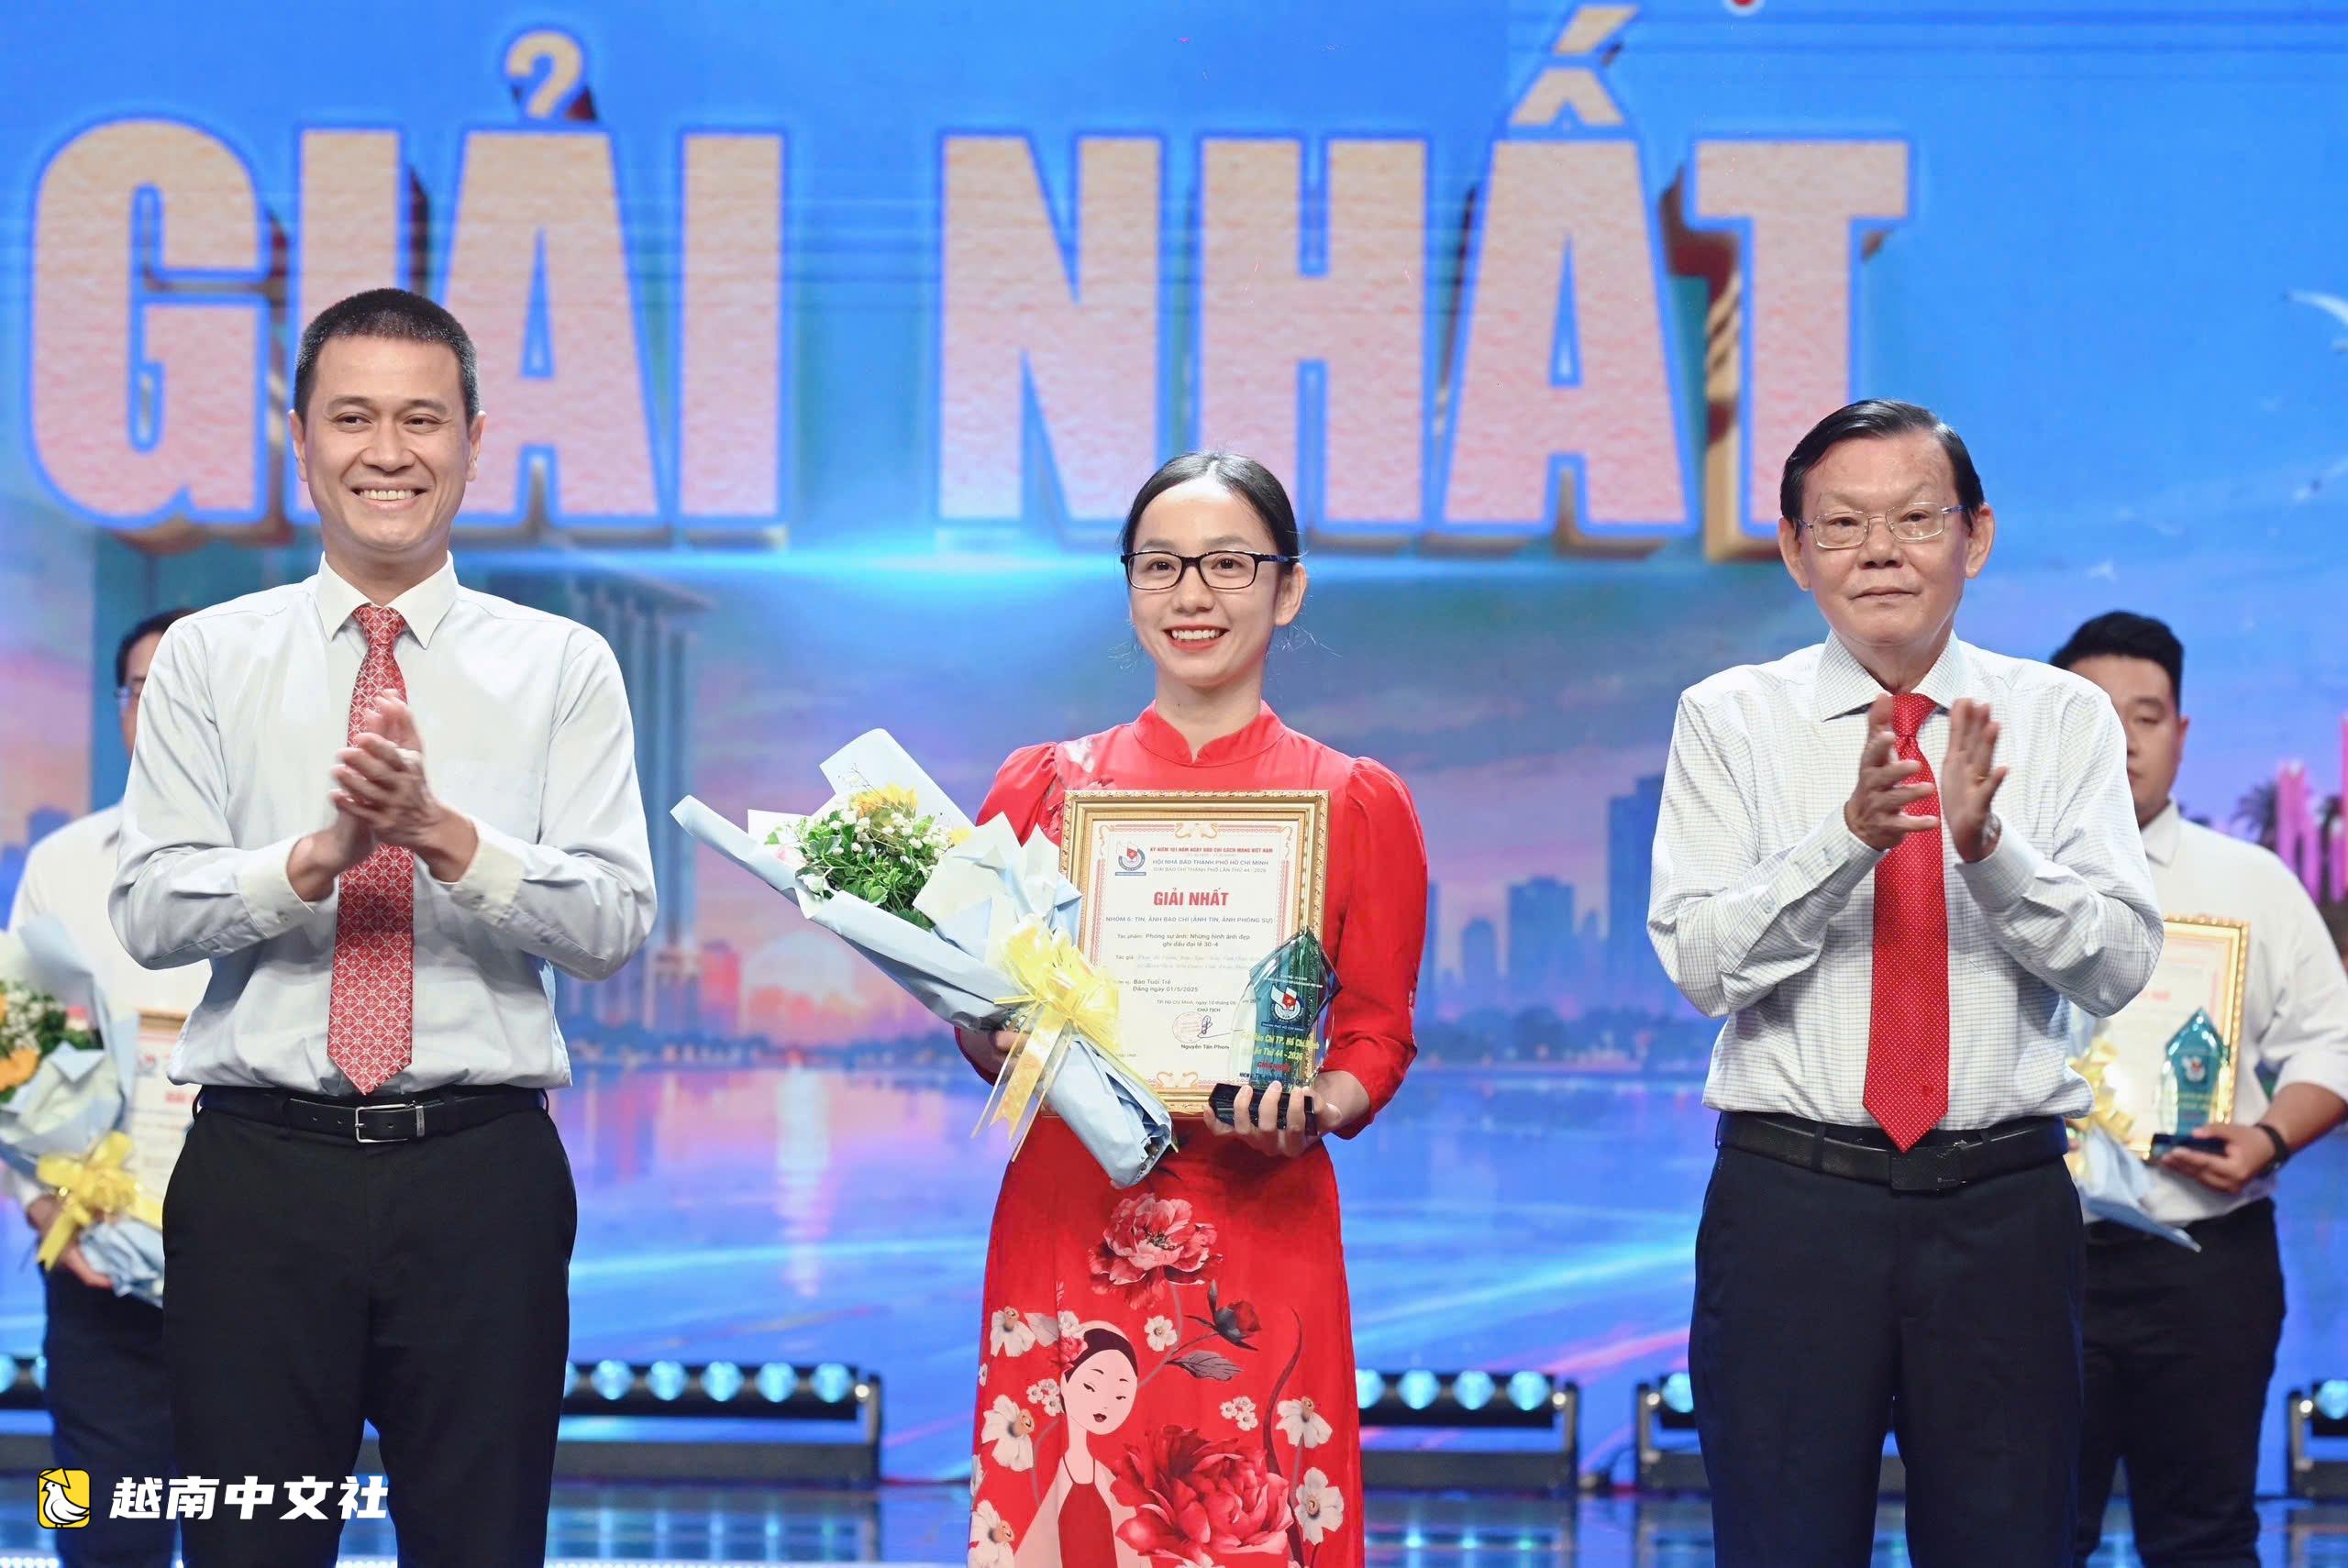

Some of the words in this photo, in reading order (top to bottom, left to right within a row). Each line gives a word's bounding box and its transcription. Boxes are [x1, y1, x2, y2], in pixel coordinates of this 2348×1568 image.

[31, 30, 783, 519] GIẢI
[937, 6, 1911, 528] NHẤT
[1153, 887, 1184, 906] GIẢI
[1189, 887, 1229, 906] NHẤT
